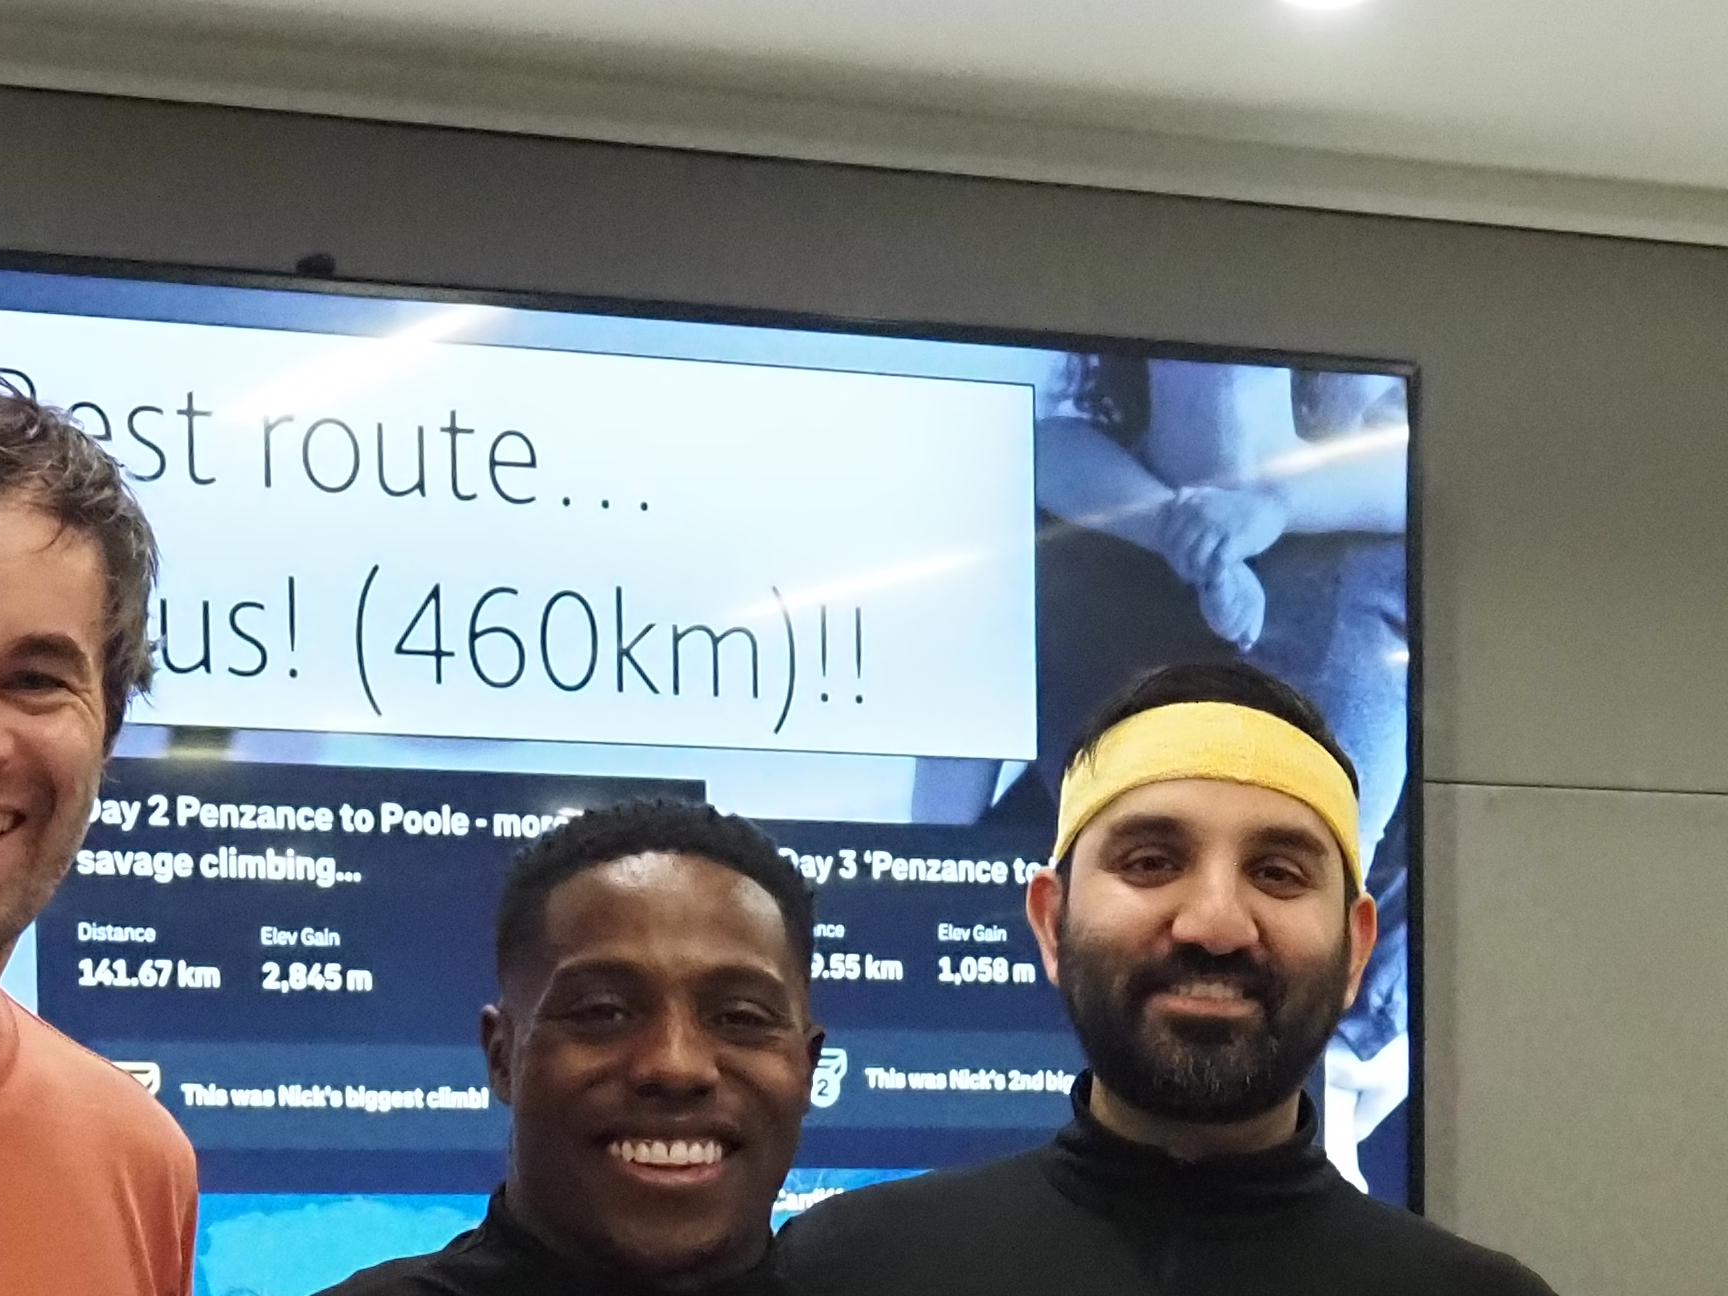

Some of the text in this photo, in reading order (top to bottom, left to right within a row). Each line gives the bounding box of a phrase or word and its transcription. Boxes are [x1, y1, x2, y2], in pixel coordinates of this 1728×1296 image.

[262, 408, 651, 513] route...
[354, 564, 867, 735] (460km)!!
[147, 794, 170, 827] 2
[176, 795, 334, 832] Penzance
[339, 803, 375, 833] to
[380, 802, 470, 836] Poole
[76, 847, 362, 888] savage climbing...
[839, 849, 857, 879] 3
[77, 921, 156, 943] Distance
[261, 926, 341, 947] Elev Gain
[937, 923, 1007, 942] Elev Gain
[78, 958, 221, 988] 141.67 km
[261, 961, 373, 993] 2,845 m
[865, 954, 903, 980] km
[938, 956, 1036, 986] 1,058 m
[865, 1067, 906, 1090] This
[908, 1071, 947, 1091] was
[949, 1068, 1005, 1091] Nick's
[1008, 1069, 1044, 1091] 2nd
[180, 1083, 229, 1107] This
[230, 1086, 275, 1107] was
[278, 1084, 343, 1108] Nick's
[344, 1085, 425, 1113] biggest
